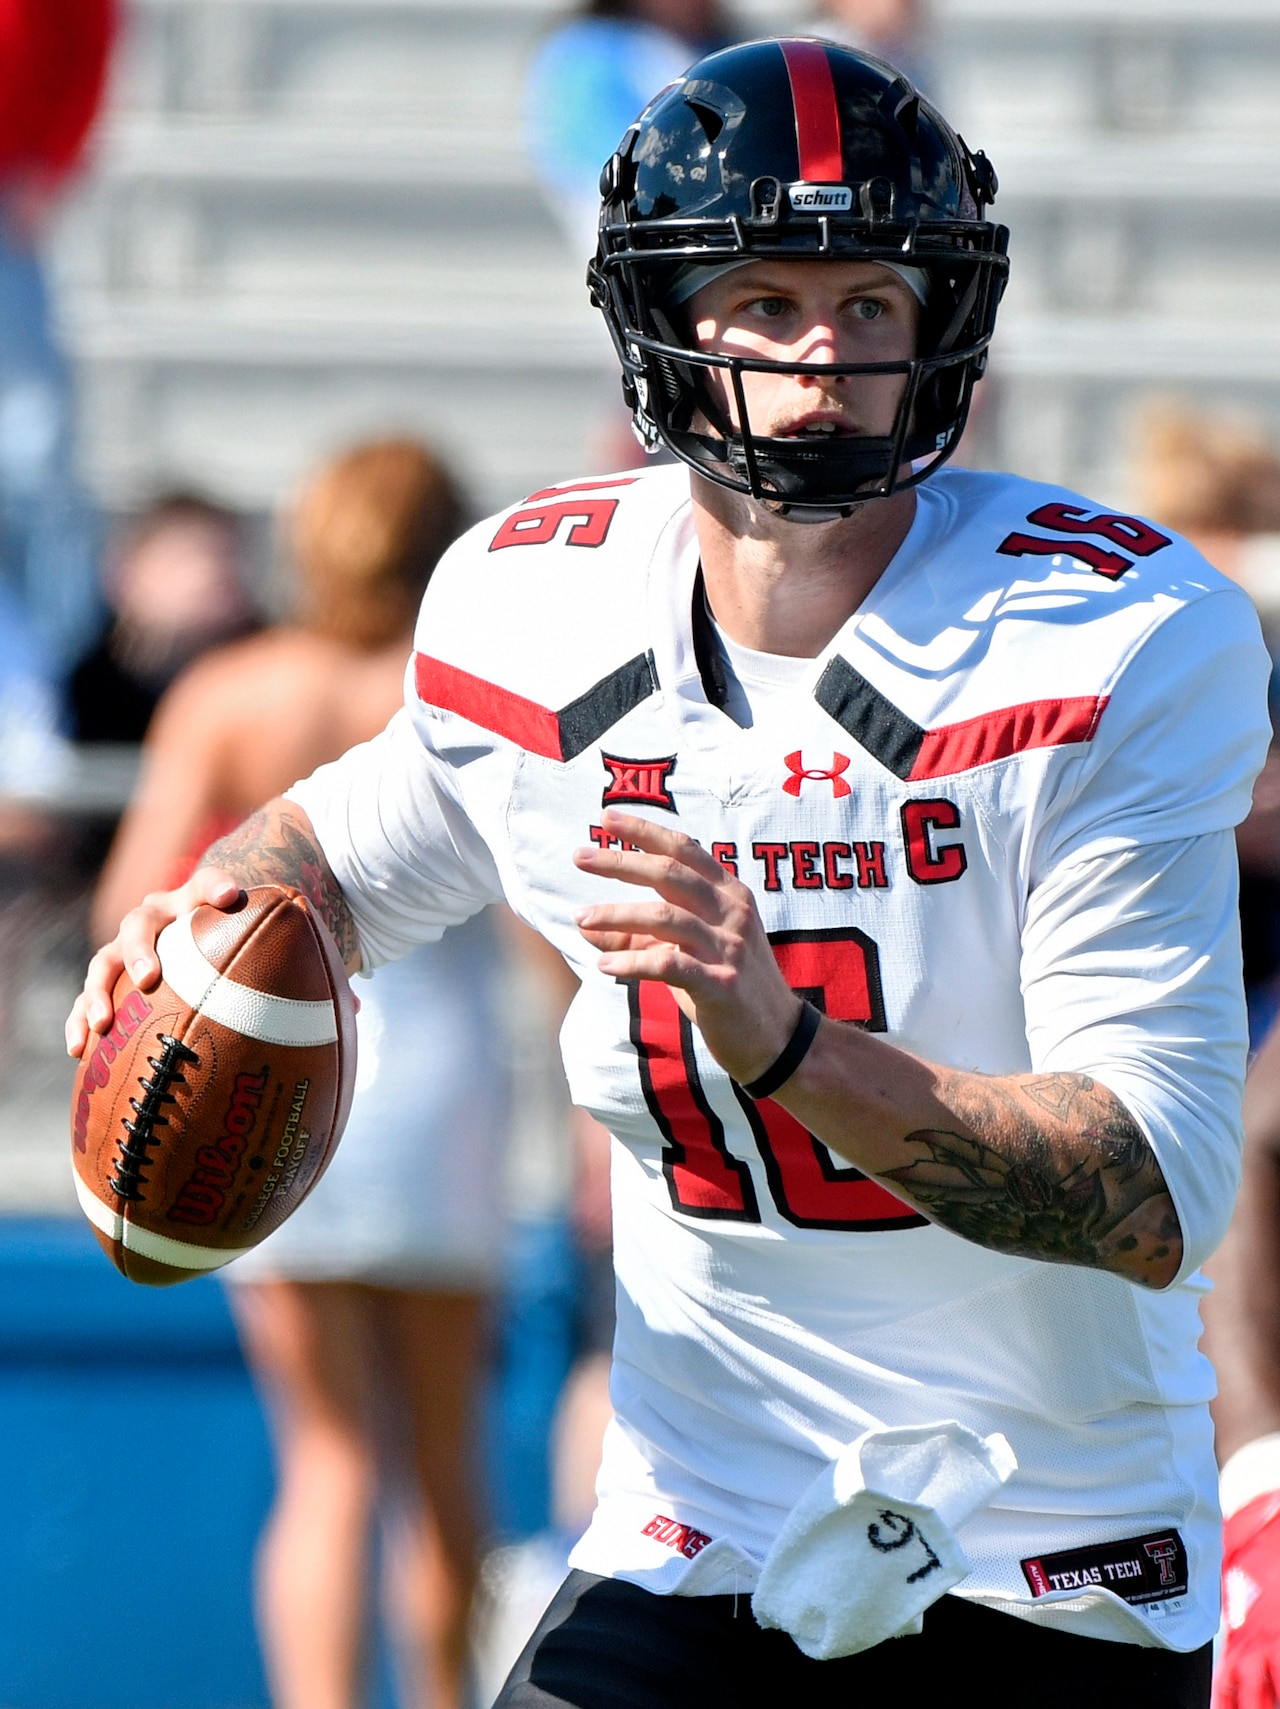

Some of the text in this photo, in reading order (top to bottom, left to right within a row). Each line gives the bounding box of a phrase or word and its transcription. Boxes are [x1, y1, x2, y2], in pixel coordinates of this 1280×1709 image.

[793, 190, 849, 206] schutt
[996, 502, 1173, 582] 16
[752, 841, 889, 892] TECH
[900, 797, 967, 885] C
[166, 1071, 267, 1226] Wilson
[273, 1078, 310, 1169] FOOTBALL
[277, 1129, 310, 1196] PLAYOFF
[640, 1514, 713, 1560] GUNS
[1048, 1559, 1142, 1590] TEXAS TECH
